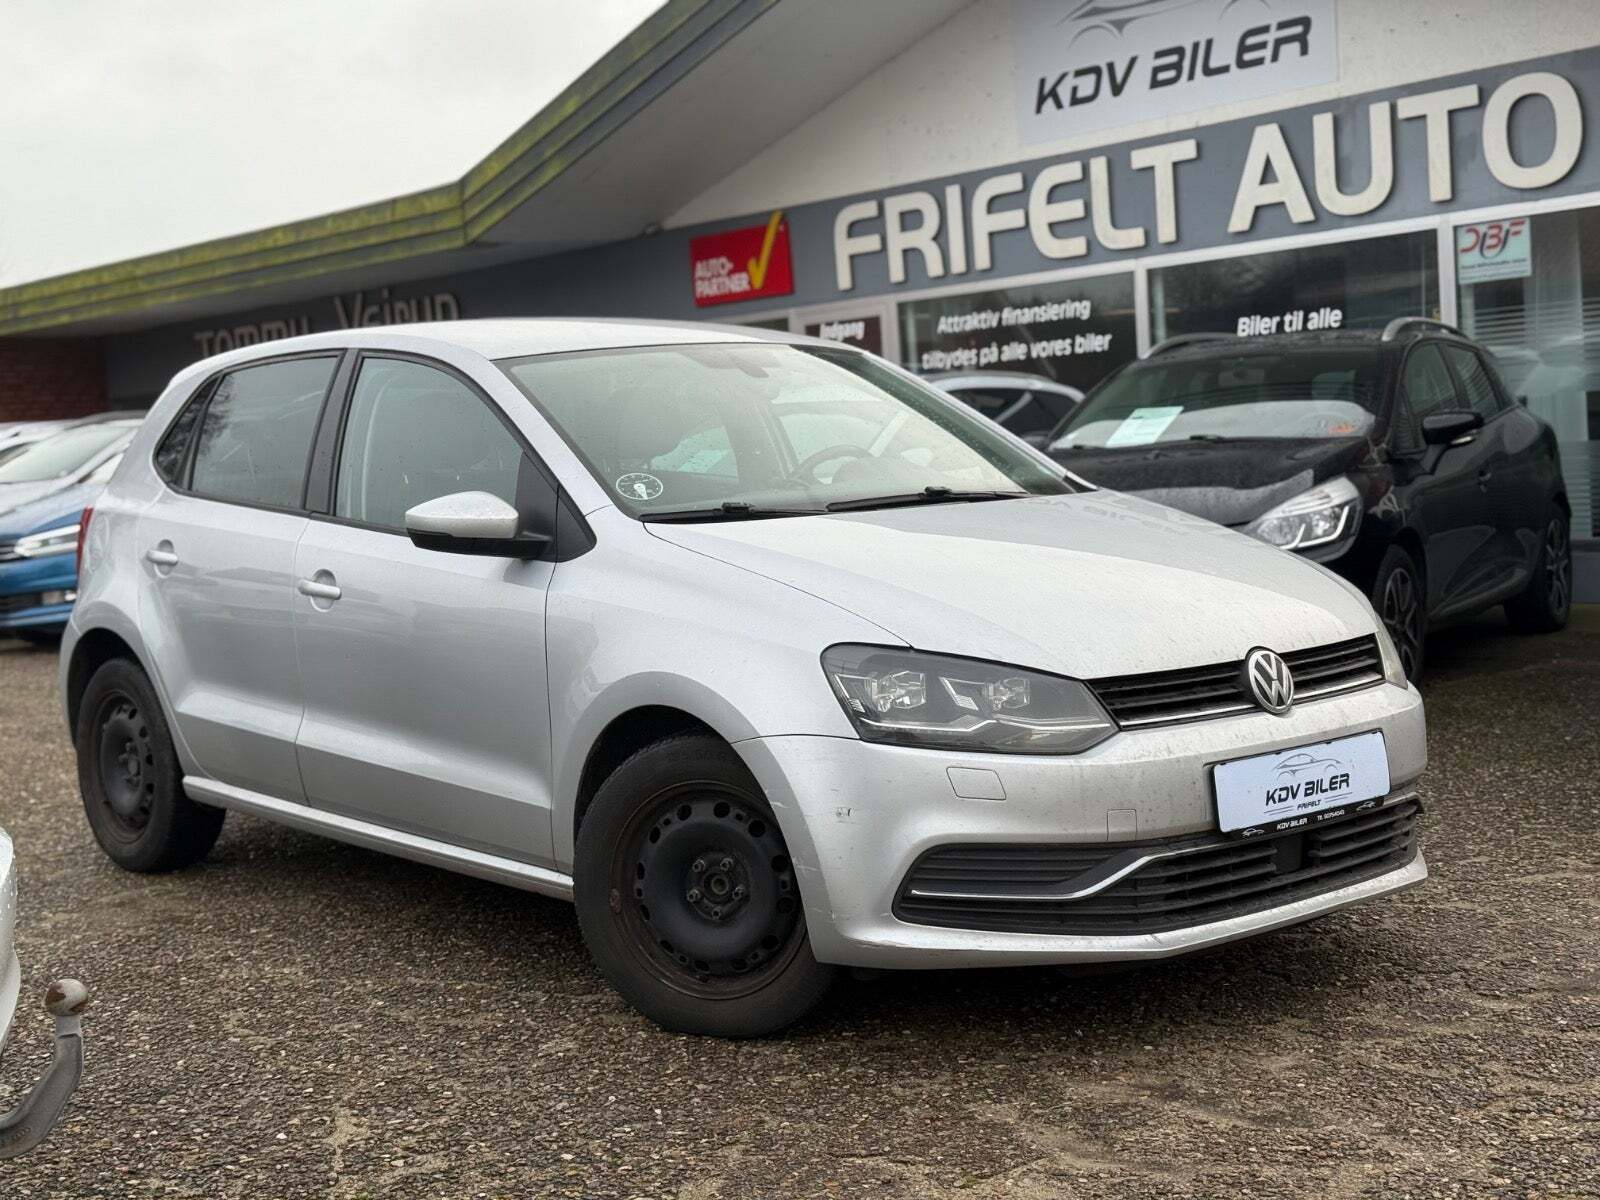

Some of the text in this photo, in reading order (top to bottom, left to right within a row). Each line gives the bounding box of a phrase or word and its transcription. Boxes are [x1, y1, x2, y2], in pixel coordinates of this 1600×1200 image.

[1035, 15, 1313, 115] KDV BILER
[833, 71, 1584, 292] FRIFELT AUTO
[694, 270, 752, 299] PARTNER
[937, 299, 1092, 335] Attraktiv finansiering
[1237, 306, 1343, 338] Biler til alle
[921, 331, 1113, 371] tilbydes på alle vores biler
[1265, 772, 1350, 807] KDV BILER
